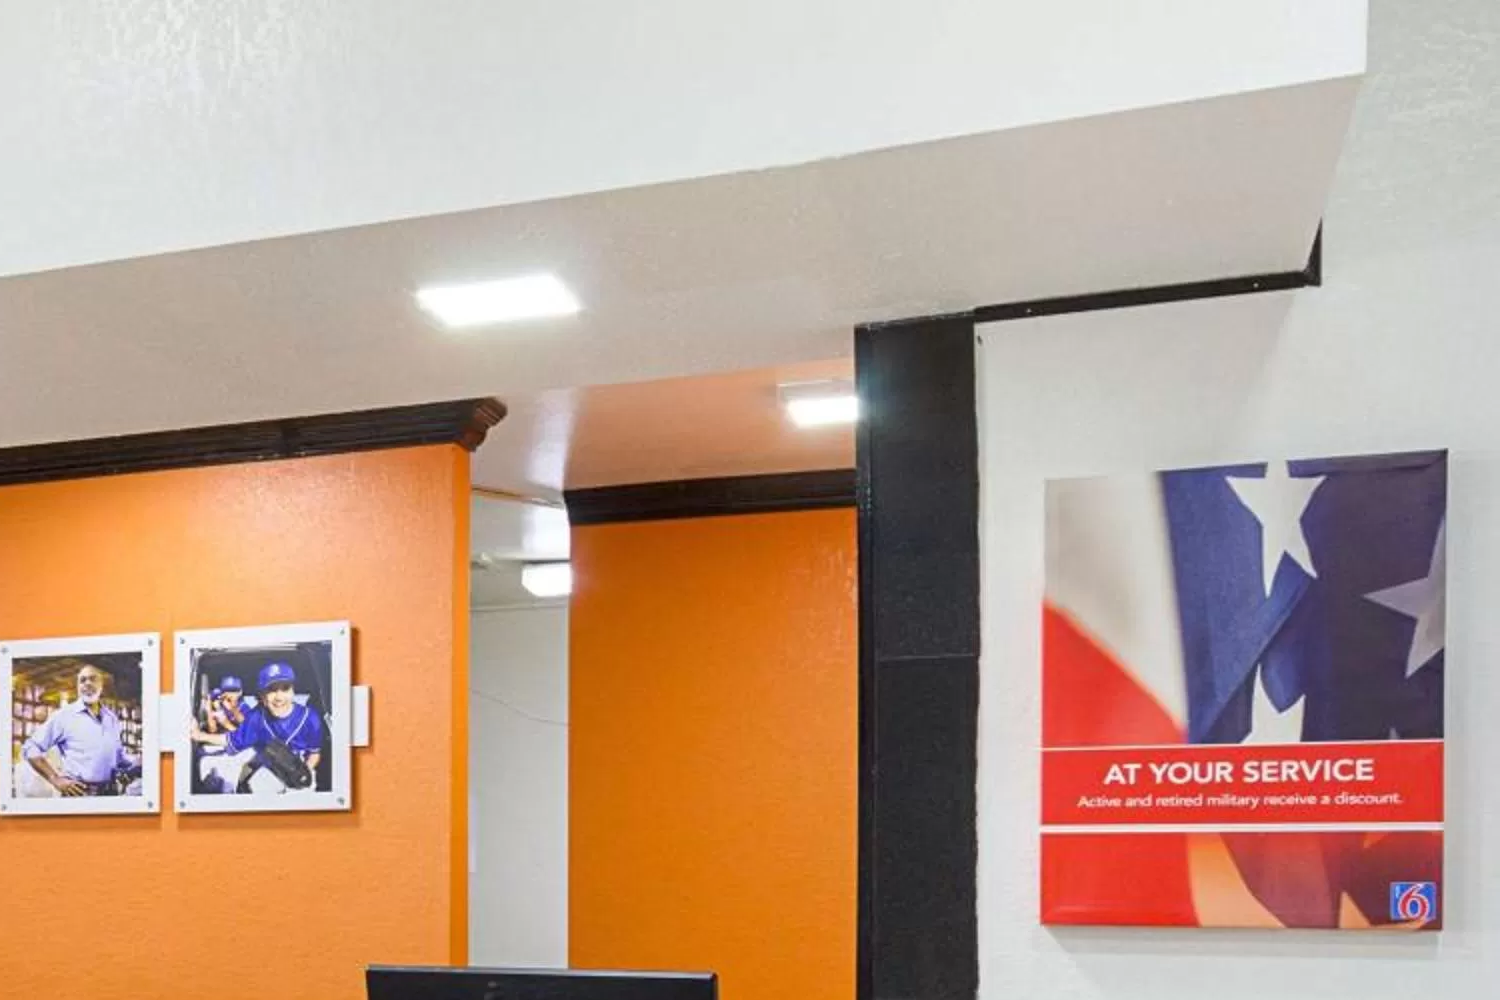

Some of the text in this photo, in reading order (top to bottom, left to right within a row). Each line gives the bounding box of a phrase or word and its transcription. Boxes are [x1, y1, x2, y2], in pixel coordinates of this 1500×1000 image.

[1103, 758, 1375, 785] AT YOUR SERVICE
[1077, 791, 1404, 810] Active and retired military receive a discount.
